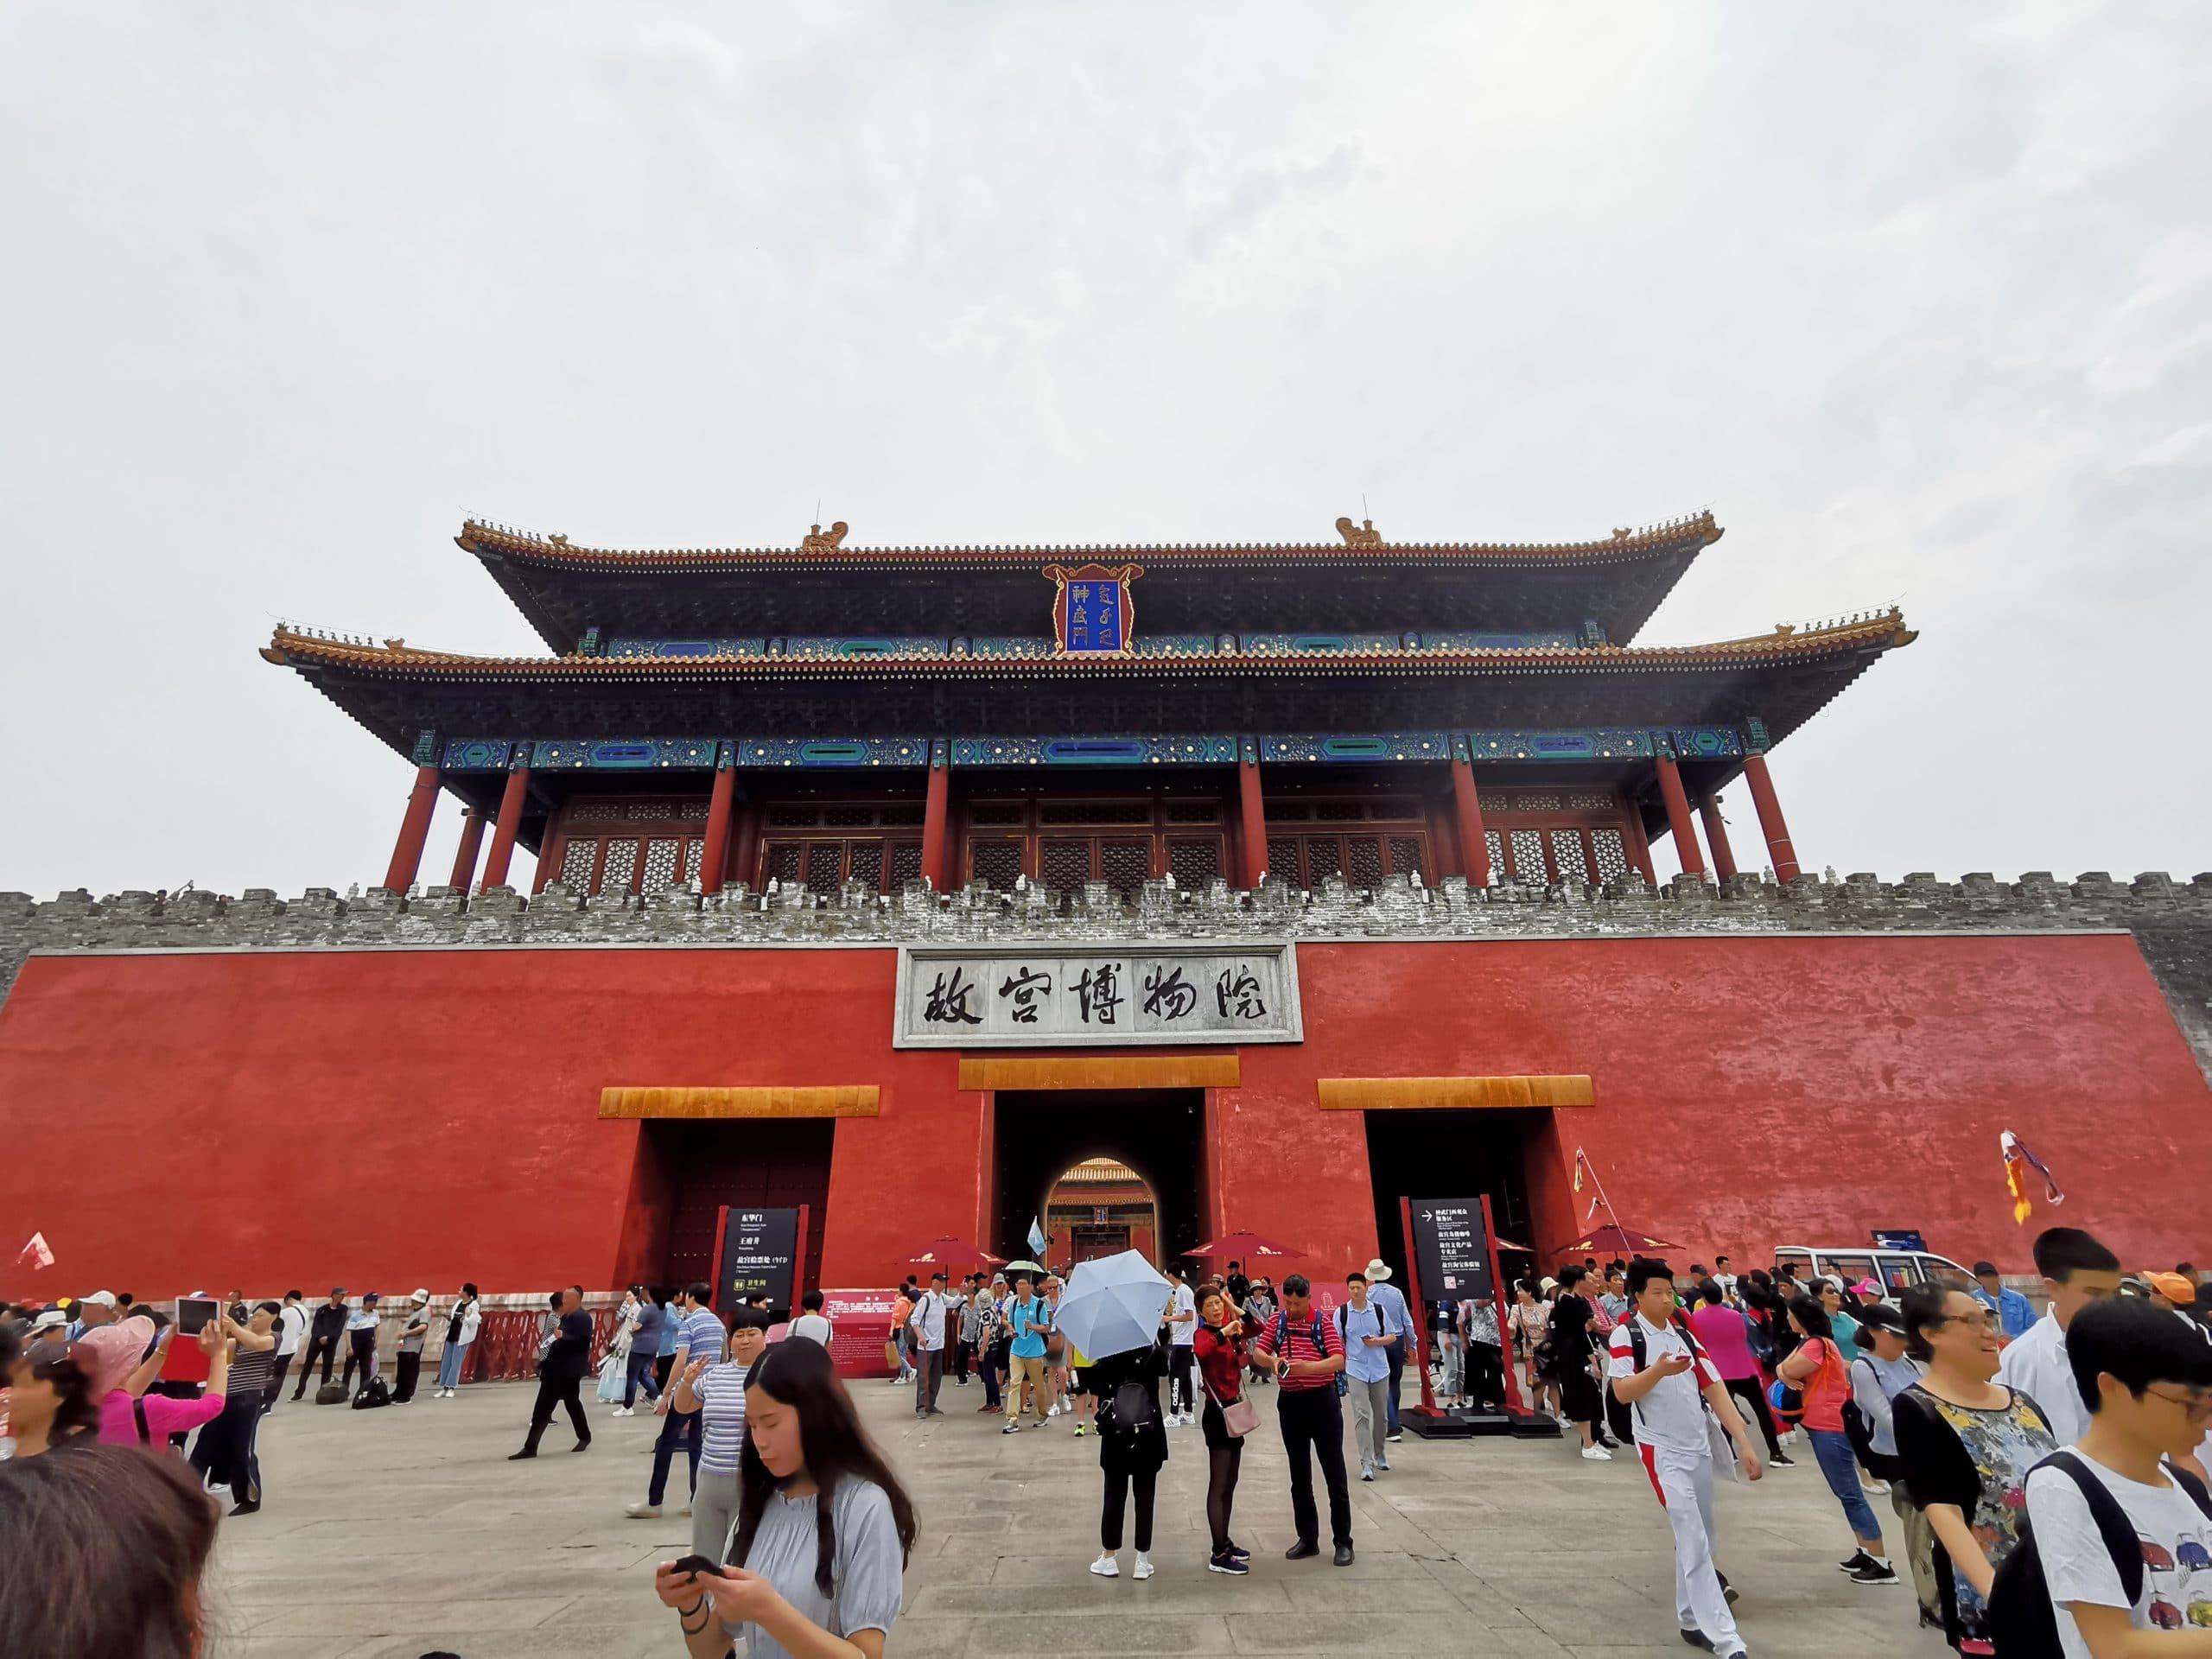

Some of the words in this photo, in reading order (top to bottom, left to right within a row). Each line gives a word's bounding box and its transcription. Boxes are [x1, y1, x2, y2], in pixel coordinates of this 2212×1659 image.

[1071, 584, 1090, 646] 神武門
[923, 963, 1267, 1025] 故宫博物院
[741, 1213, 763, 1223] 东华门
[740, 1236, 760, 1245] 王府井
